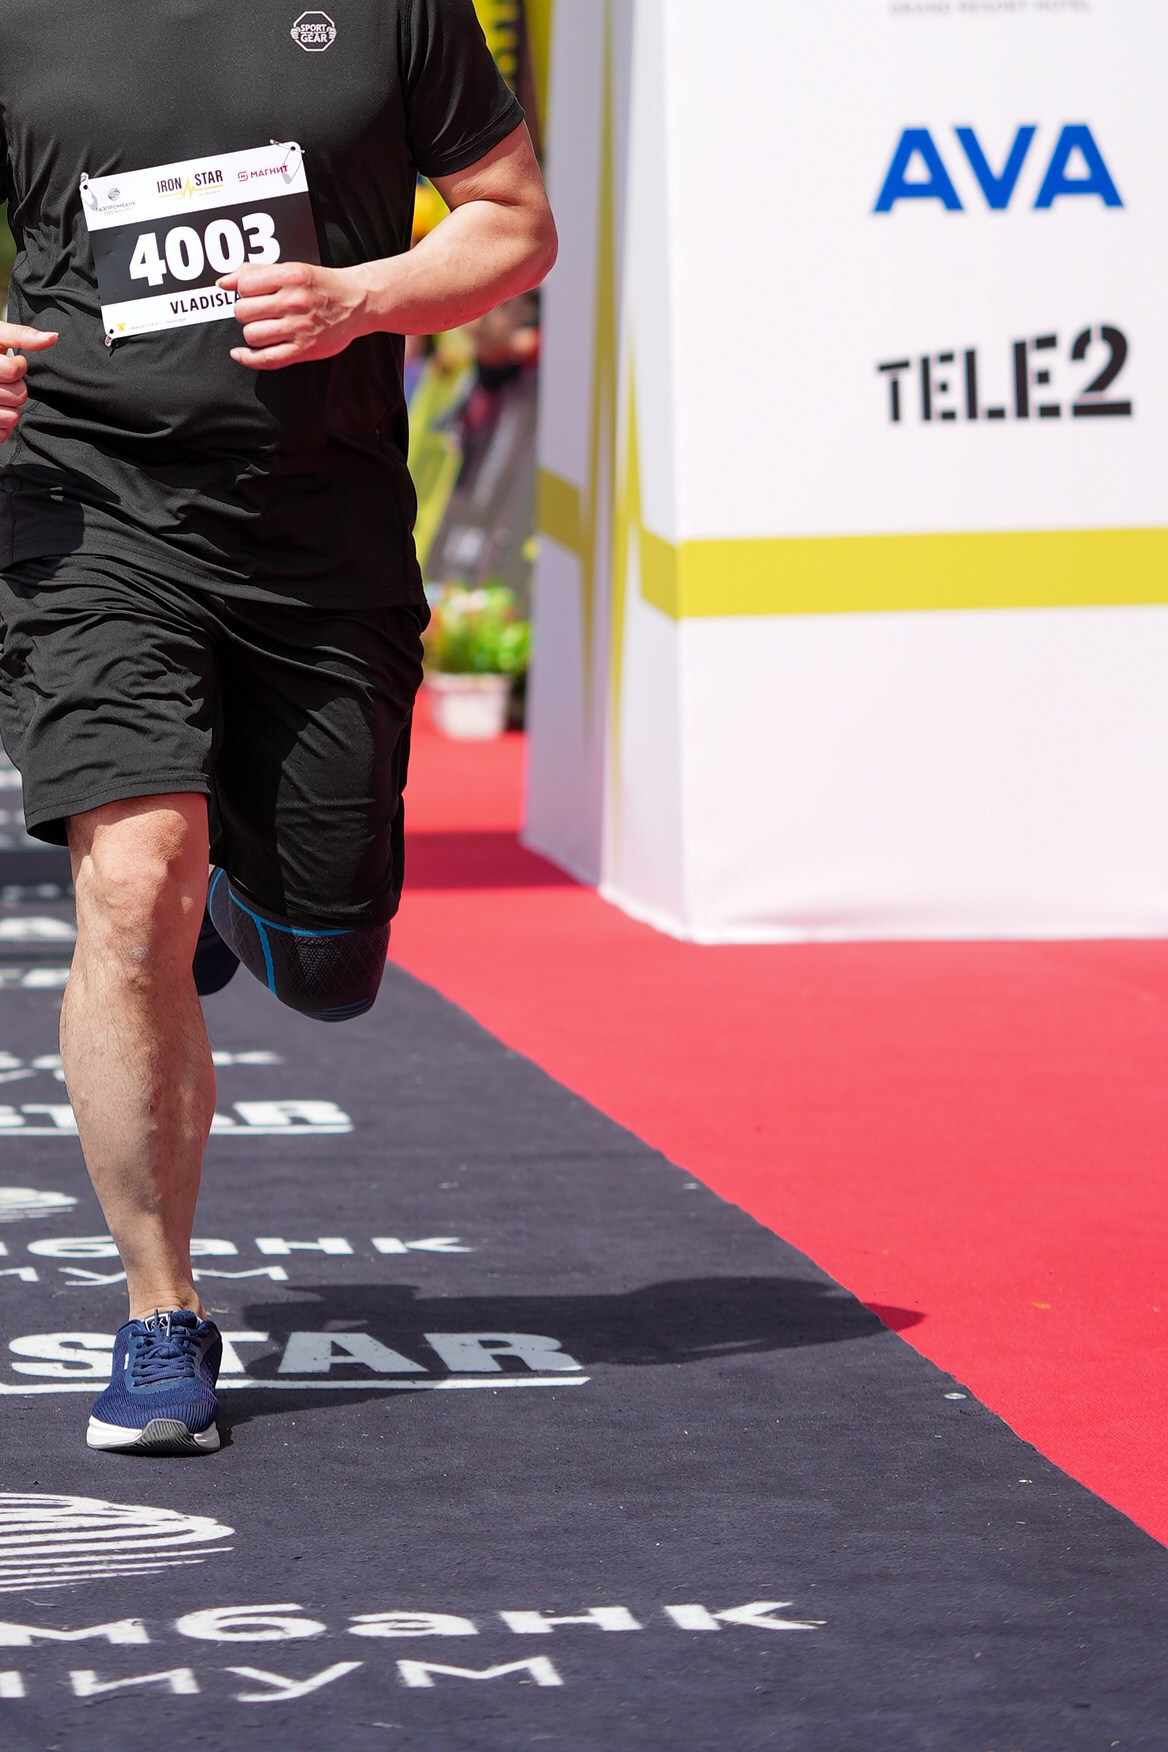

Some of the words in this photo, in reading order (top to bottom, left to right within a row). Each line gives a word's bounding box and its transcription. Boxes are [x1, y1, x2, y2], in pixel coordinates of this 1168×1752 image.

[300, 23, 327, 32] SPORT
[300, 33, 328, 43] GEAR
[250, 165, 289, 179] МАГНИТ
[871, 123, 1125, 213] AVA
[156, 177, 183, 194] IRON
[194, 169, 224, 187] STAR
[129, 212, 280, 287] 4003
[877, 322, 1132, 423] TELE2
